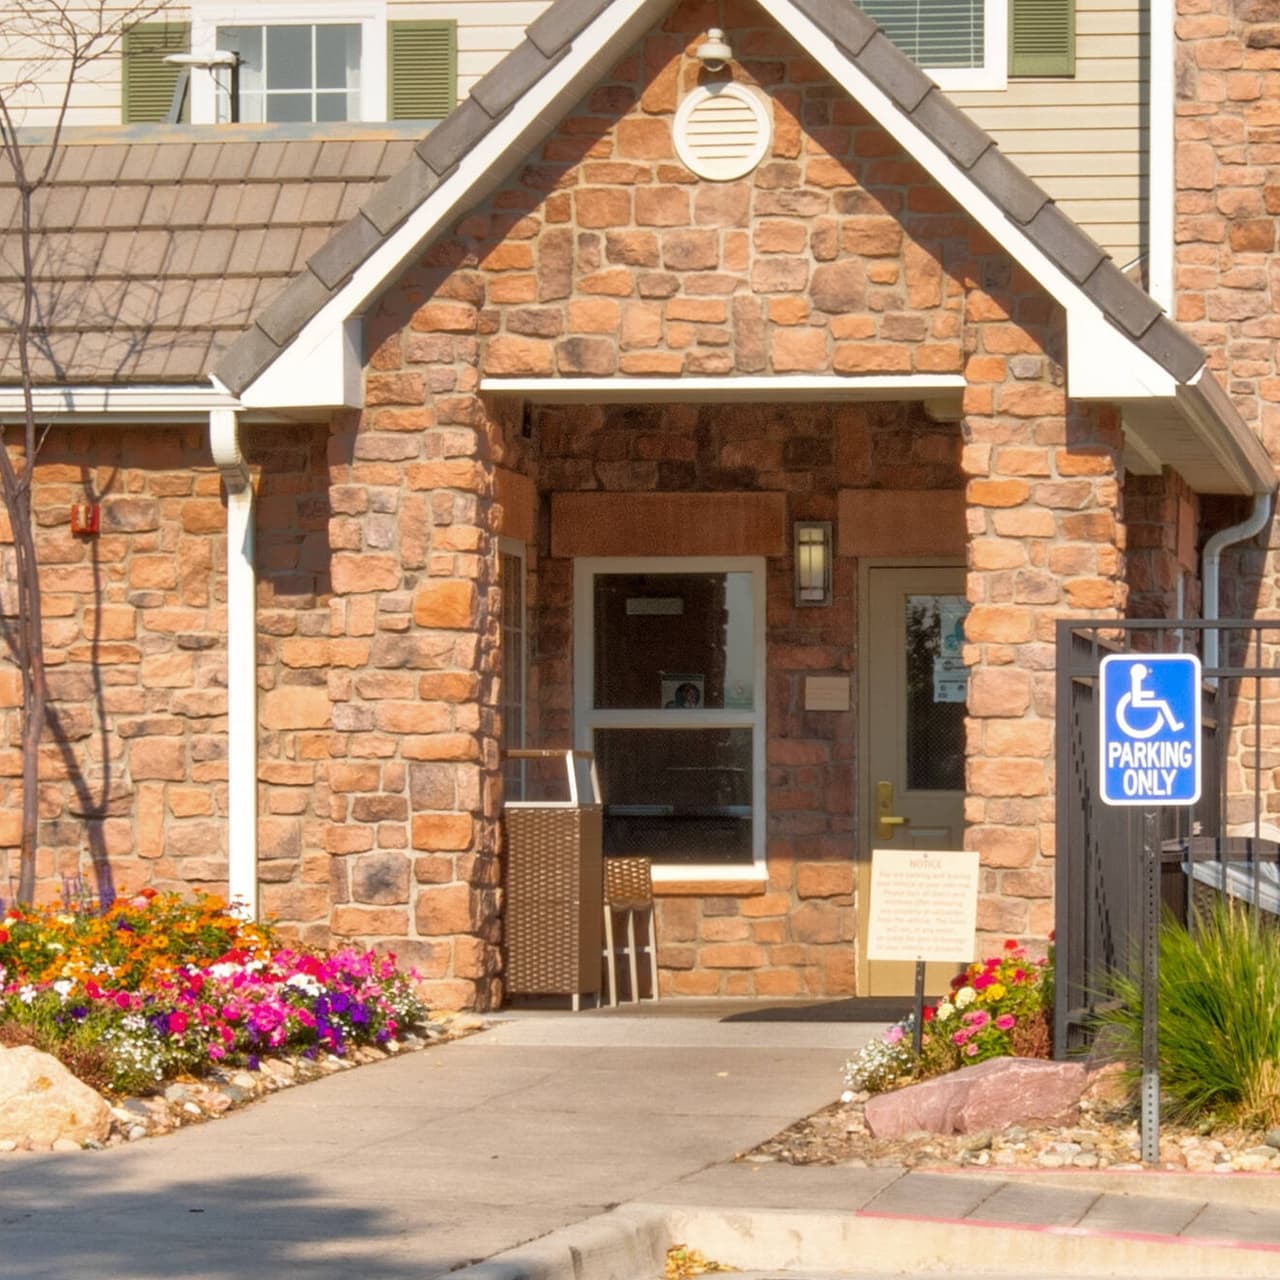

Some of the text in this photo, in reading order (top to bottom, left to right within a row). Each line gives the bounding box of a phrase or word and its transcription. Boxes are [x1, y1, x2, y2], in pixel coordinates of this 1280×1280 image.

[1108, 741, 1193, 769] PARKING
[1122, 768, 1178, 797] ONLY
[909, 858, 942, 869] NOTICE
